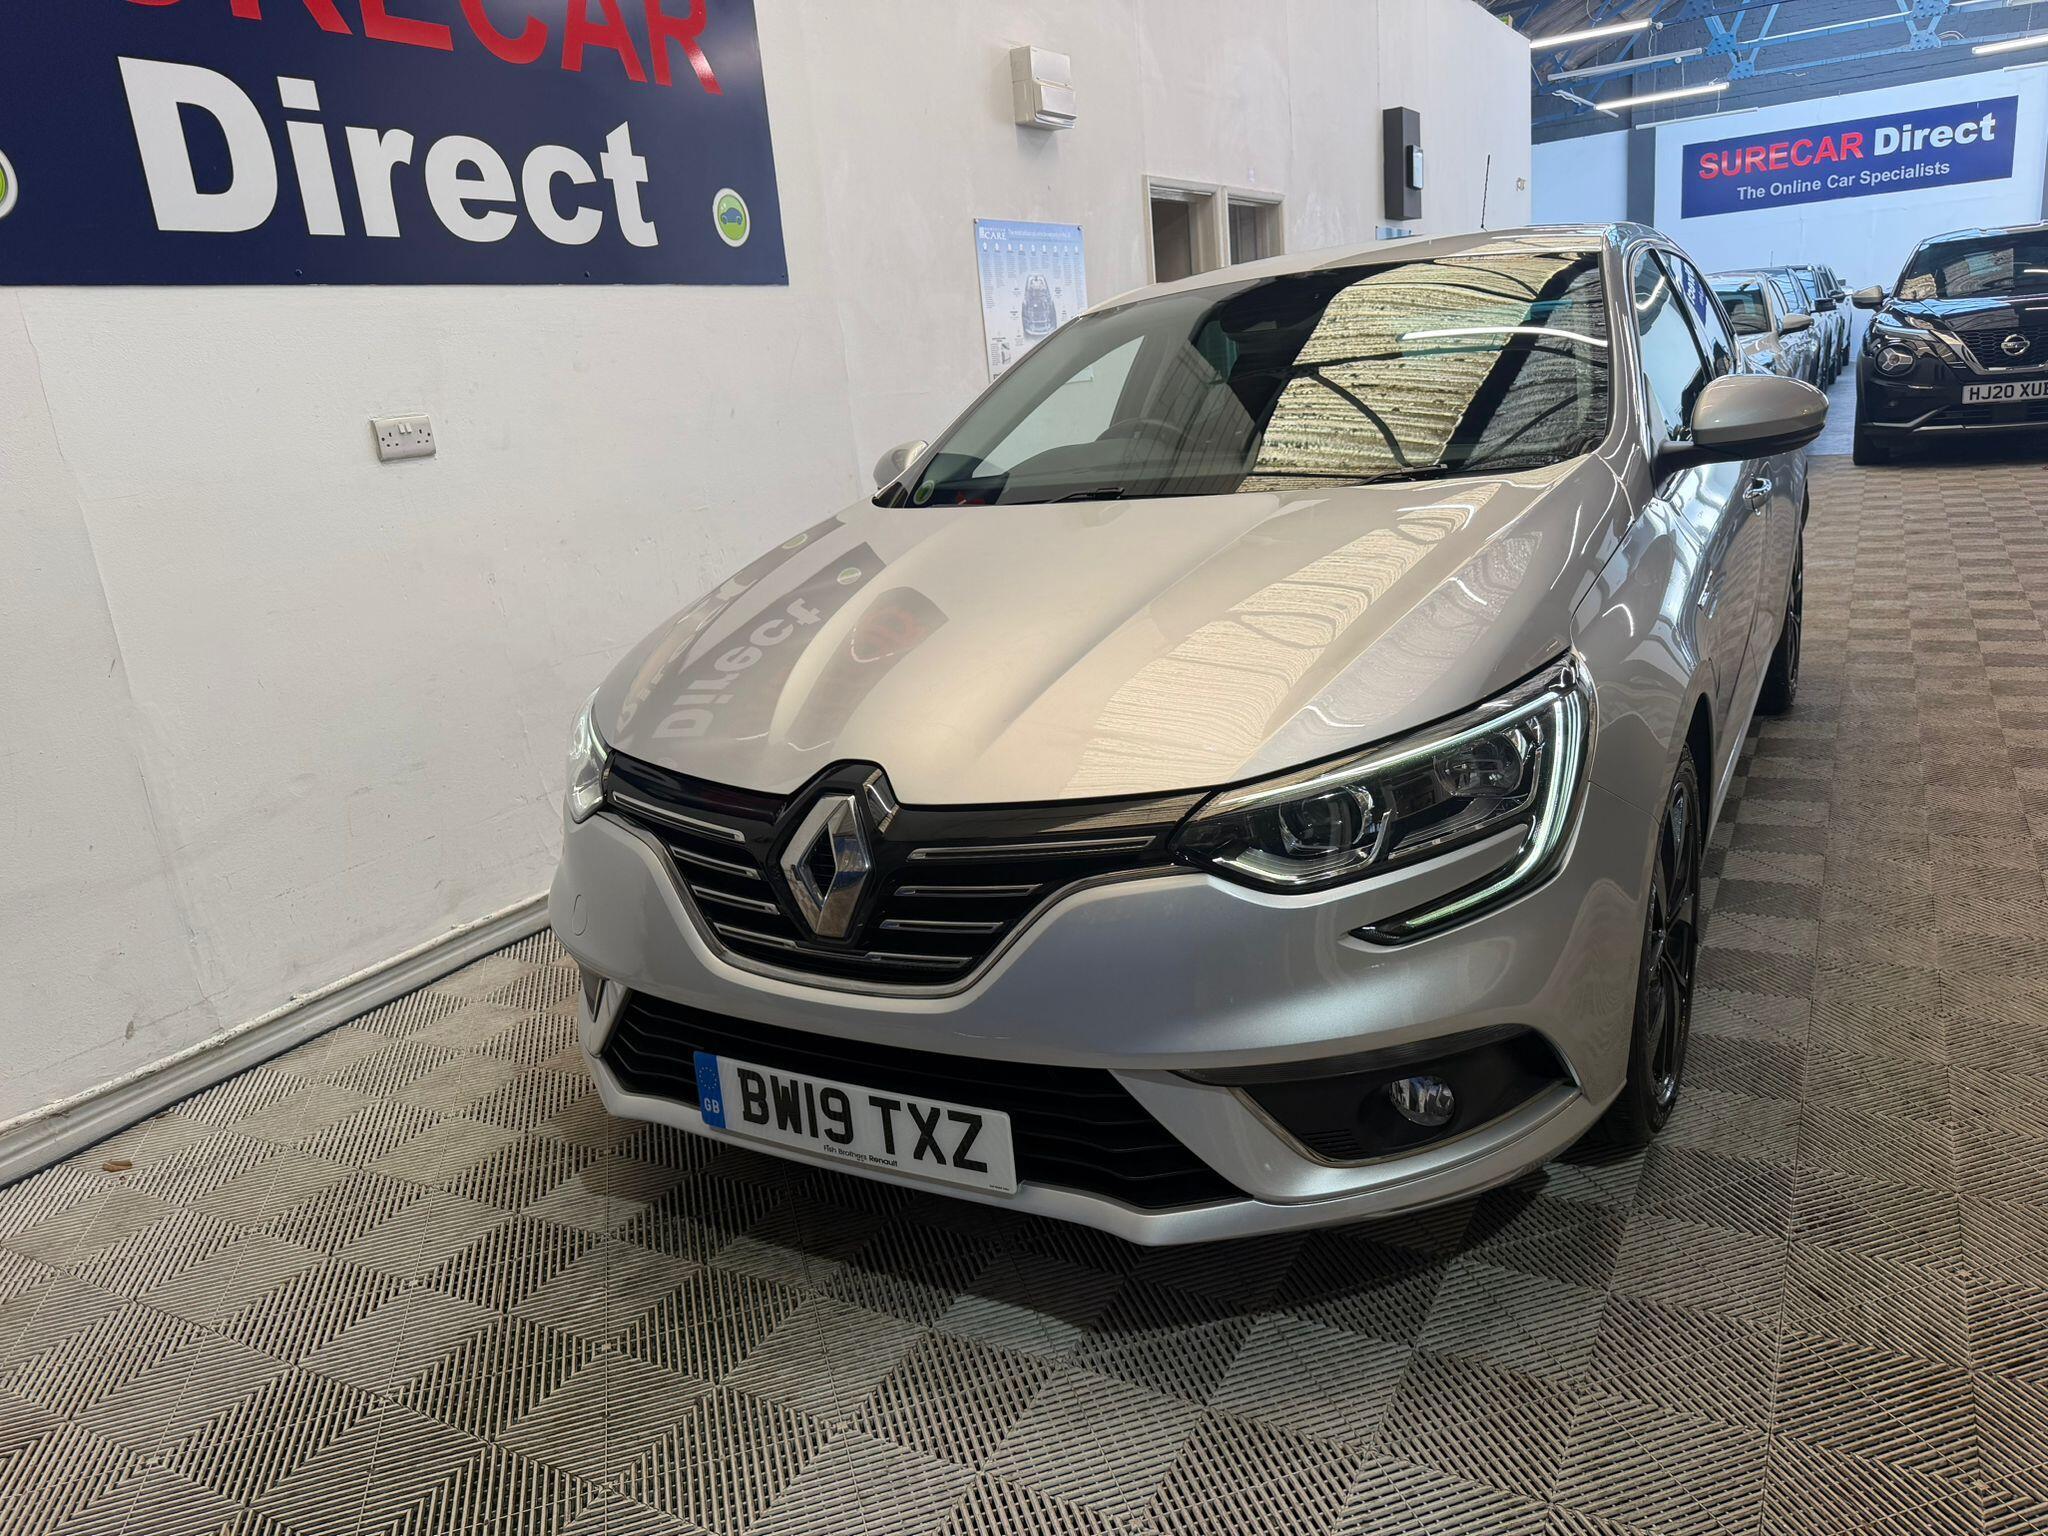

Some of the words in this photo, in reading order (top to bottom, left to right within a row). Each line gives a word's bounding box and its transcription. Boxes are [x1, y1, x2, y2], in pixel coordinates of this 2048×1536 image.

[117, 56, 659, 248] Direct
[1699, 132, 1864, 180] SURECAR
[1874, 112, 1996, 156] Direct
[1737, 186, 1766, 200] The
[1770, 179, 1821, 197] Online
[1827, 174, 1856, 189] Car
[1859, 161, 1950, 186] Specialists
[983, 231, 1007, 241] CARE
[1969, 385, 2014, 400] HJ20
[703, 1097, 720, 1114] GB
[736, 1067, 855, 1145] BW19
[868, 1095, 988, 1173] TXZ
[868, 1154, 898, 1167] Renault
